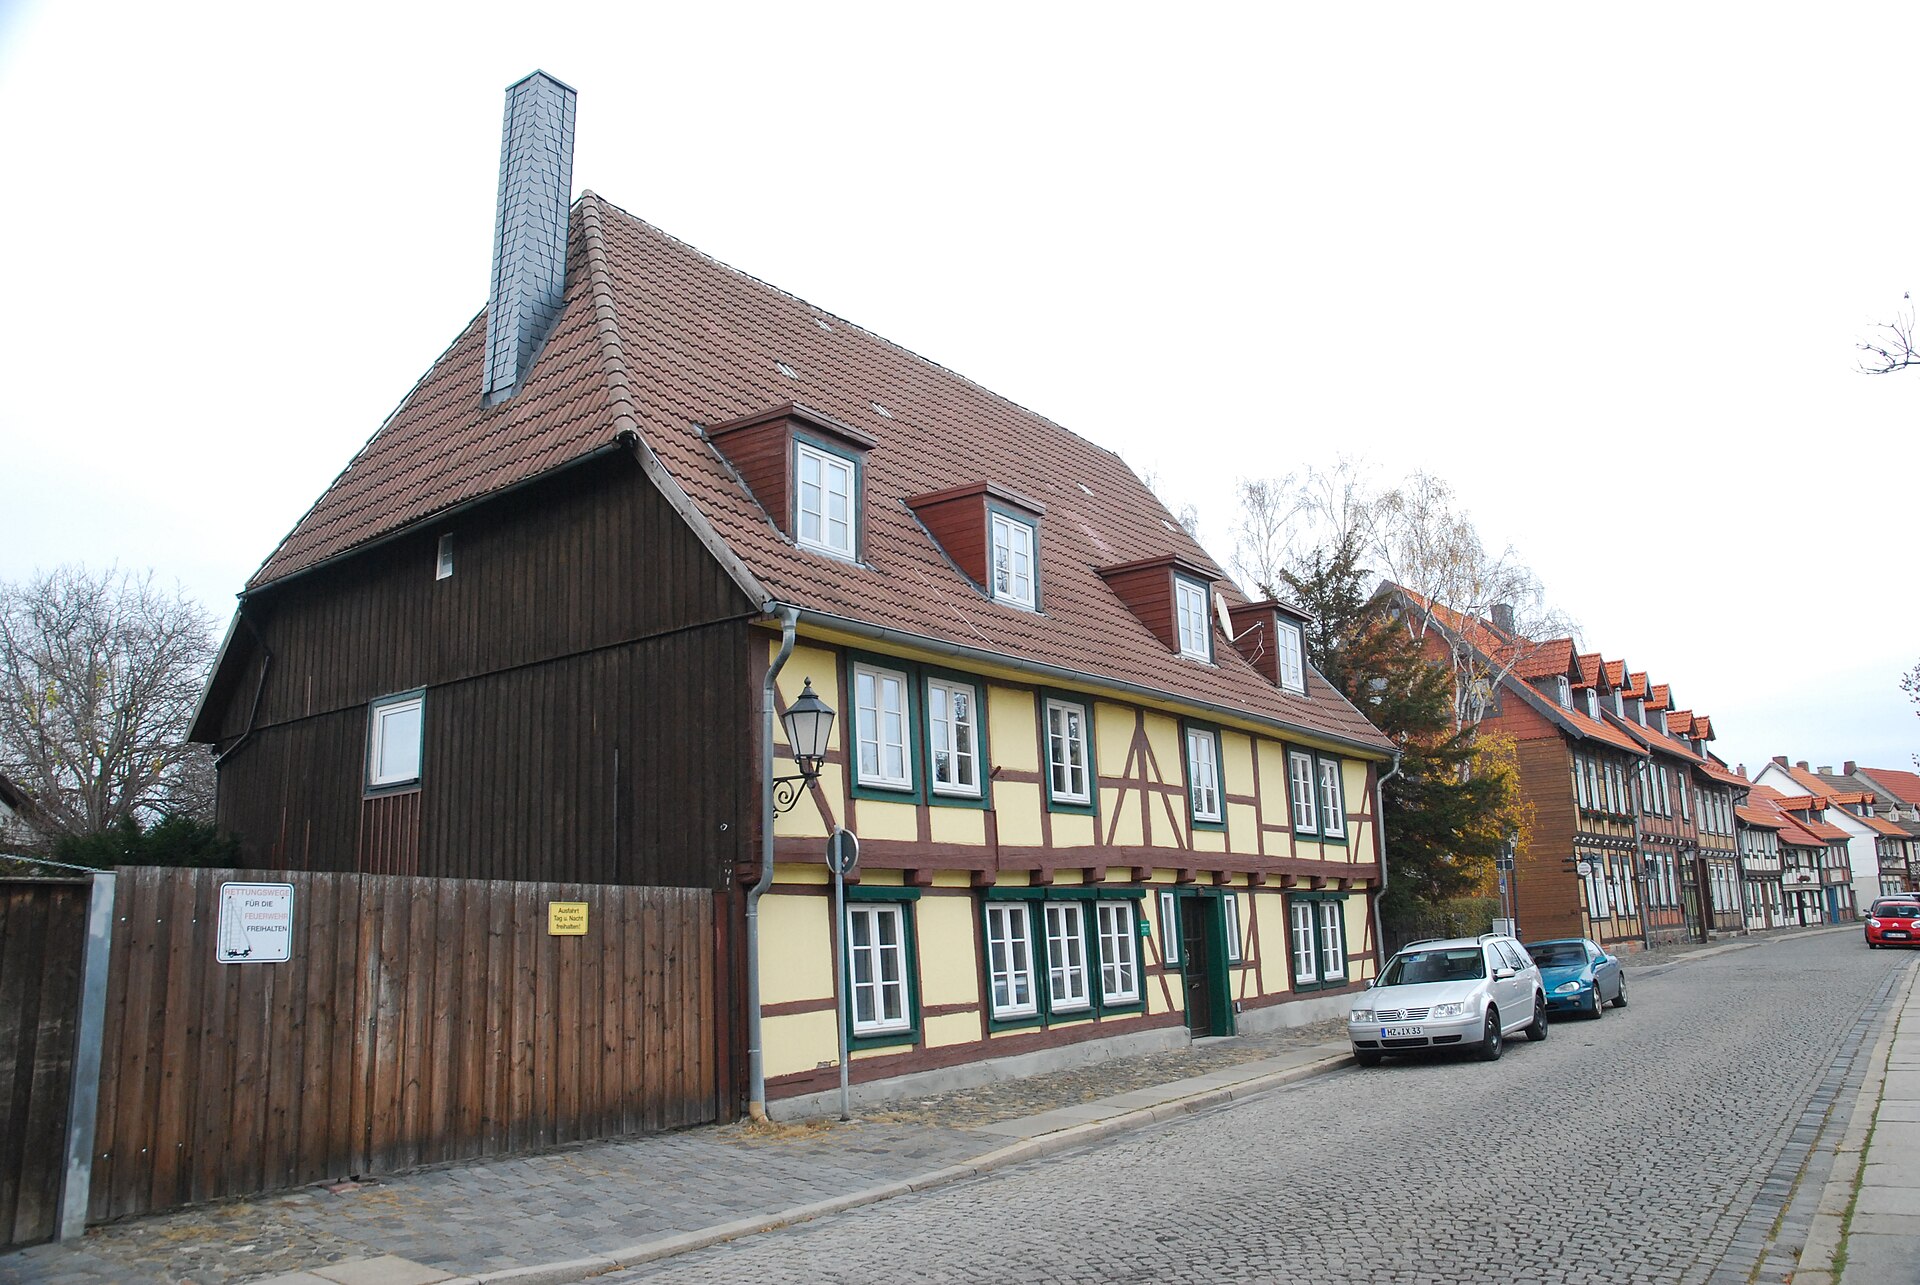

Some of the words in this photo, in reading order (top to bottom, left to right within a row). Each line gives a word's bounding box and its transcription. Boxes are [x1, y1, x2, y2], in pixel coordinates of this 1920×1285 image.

[225, 888, 289, 896] RETTUNGSWEGE
[245, 899, 260, 907] FÜR
[245, 912, 288, 920] FEUERWEHR
